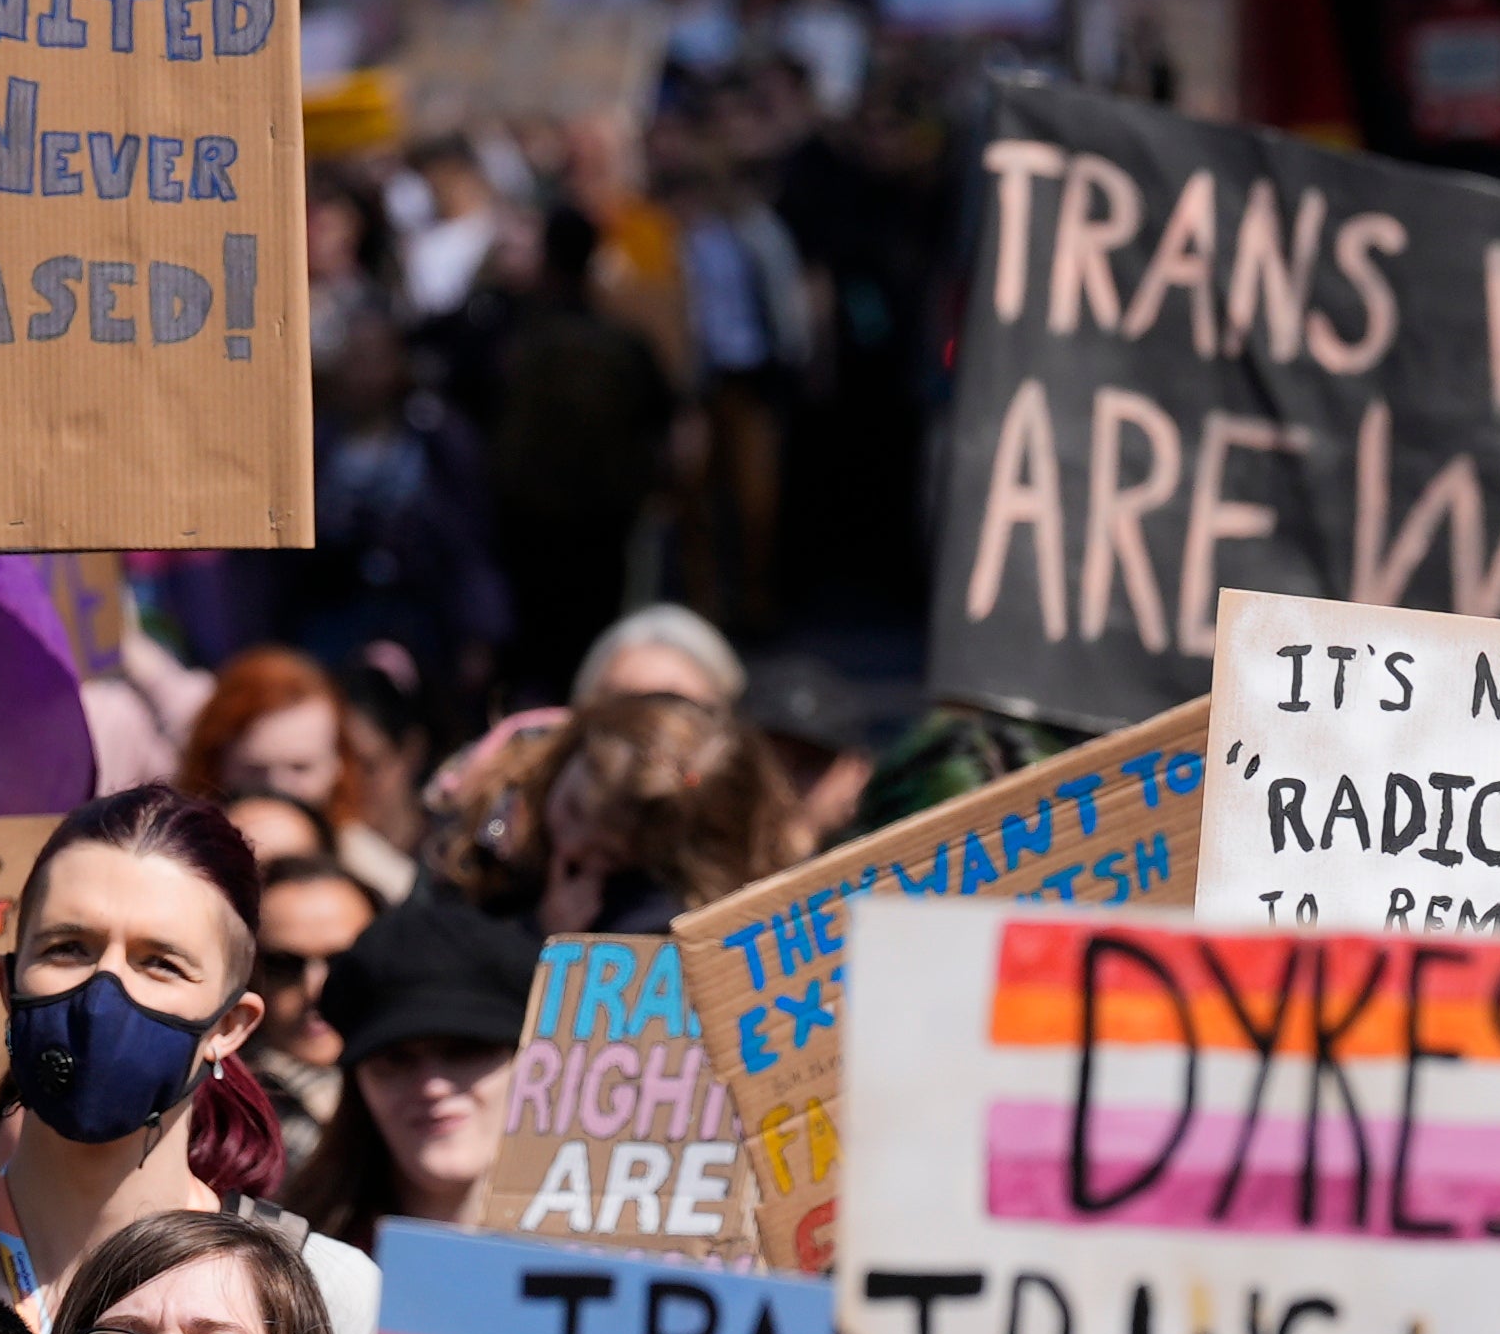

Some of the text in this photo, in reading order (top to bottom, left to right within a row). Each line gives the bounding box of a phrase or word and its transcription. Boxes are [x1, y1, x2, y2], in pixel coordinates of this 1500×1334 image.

[982, 140, 1411, 377] TRANS
[967, 379, 1313, 659] ARE
[1275, 642, 1417, 716] IT'S
[892, 774, 1103, 900] WANT
[1121, 750, 1203, 809] TO
[1258, 890, 1319, 932] TO
[538, 940, 702, 1042] TRA
[517, 1139, 738, 1236] ARE
